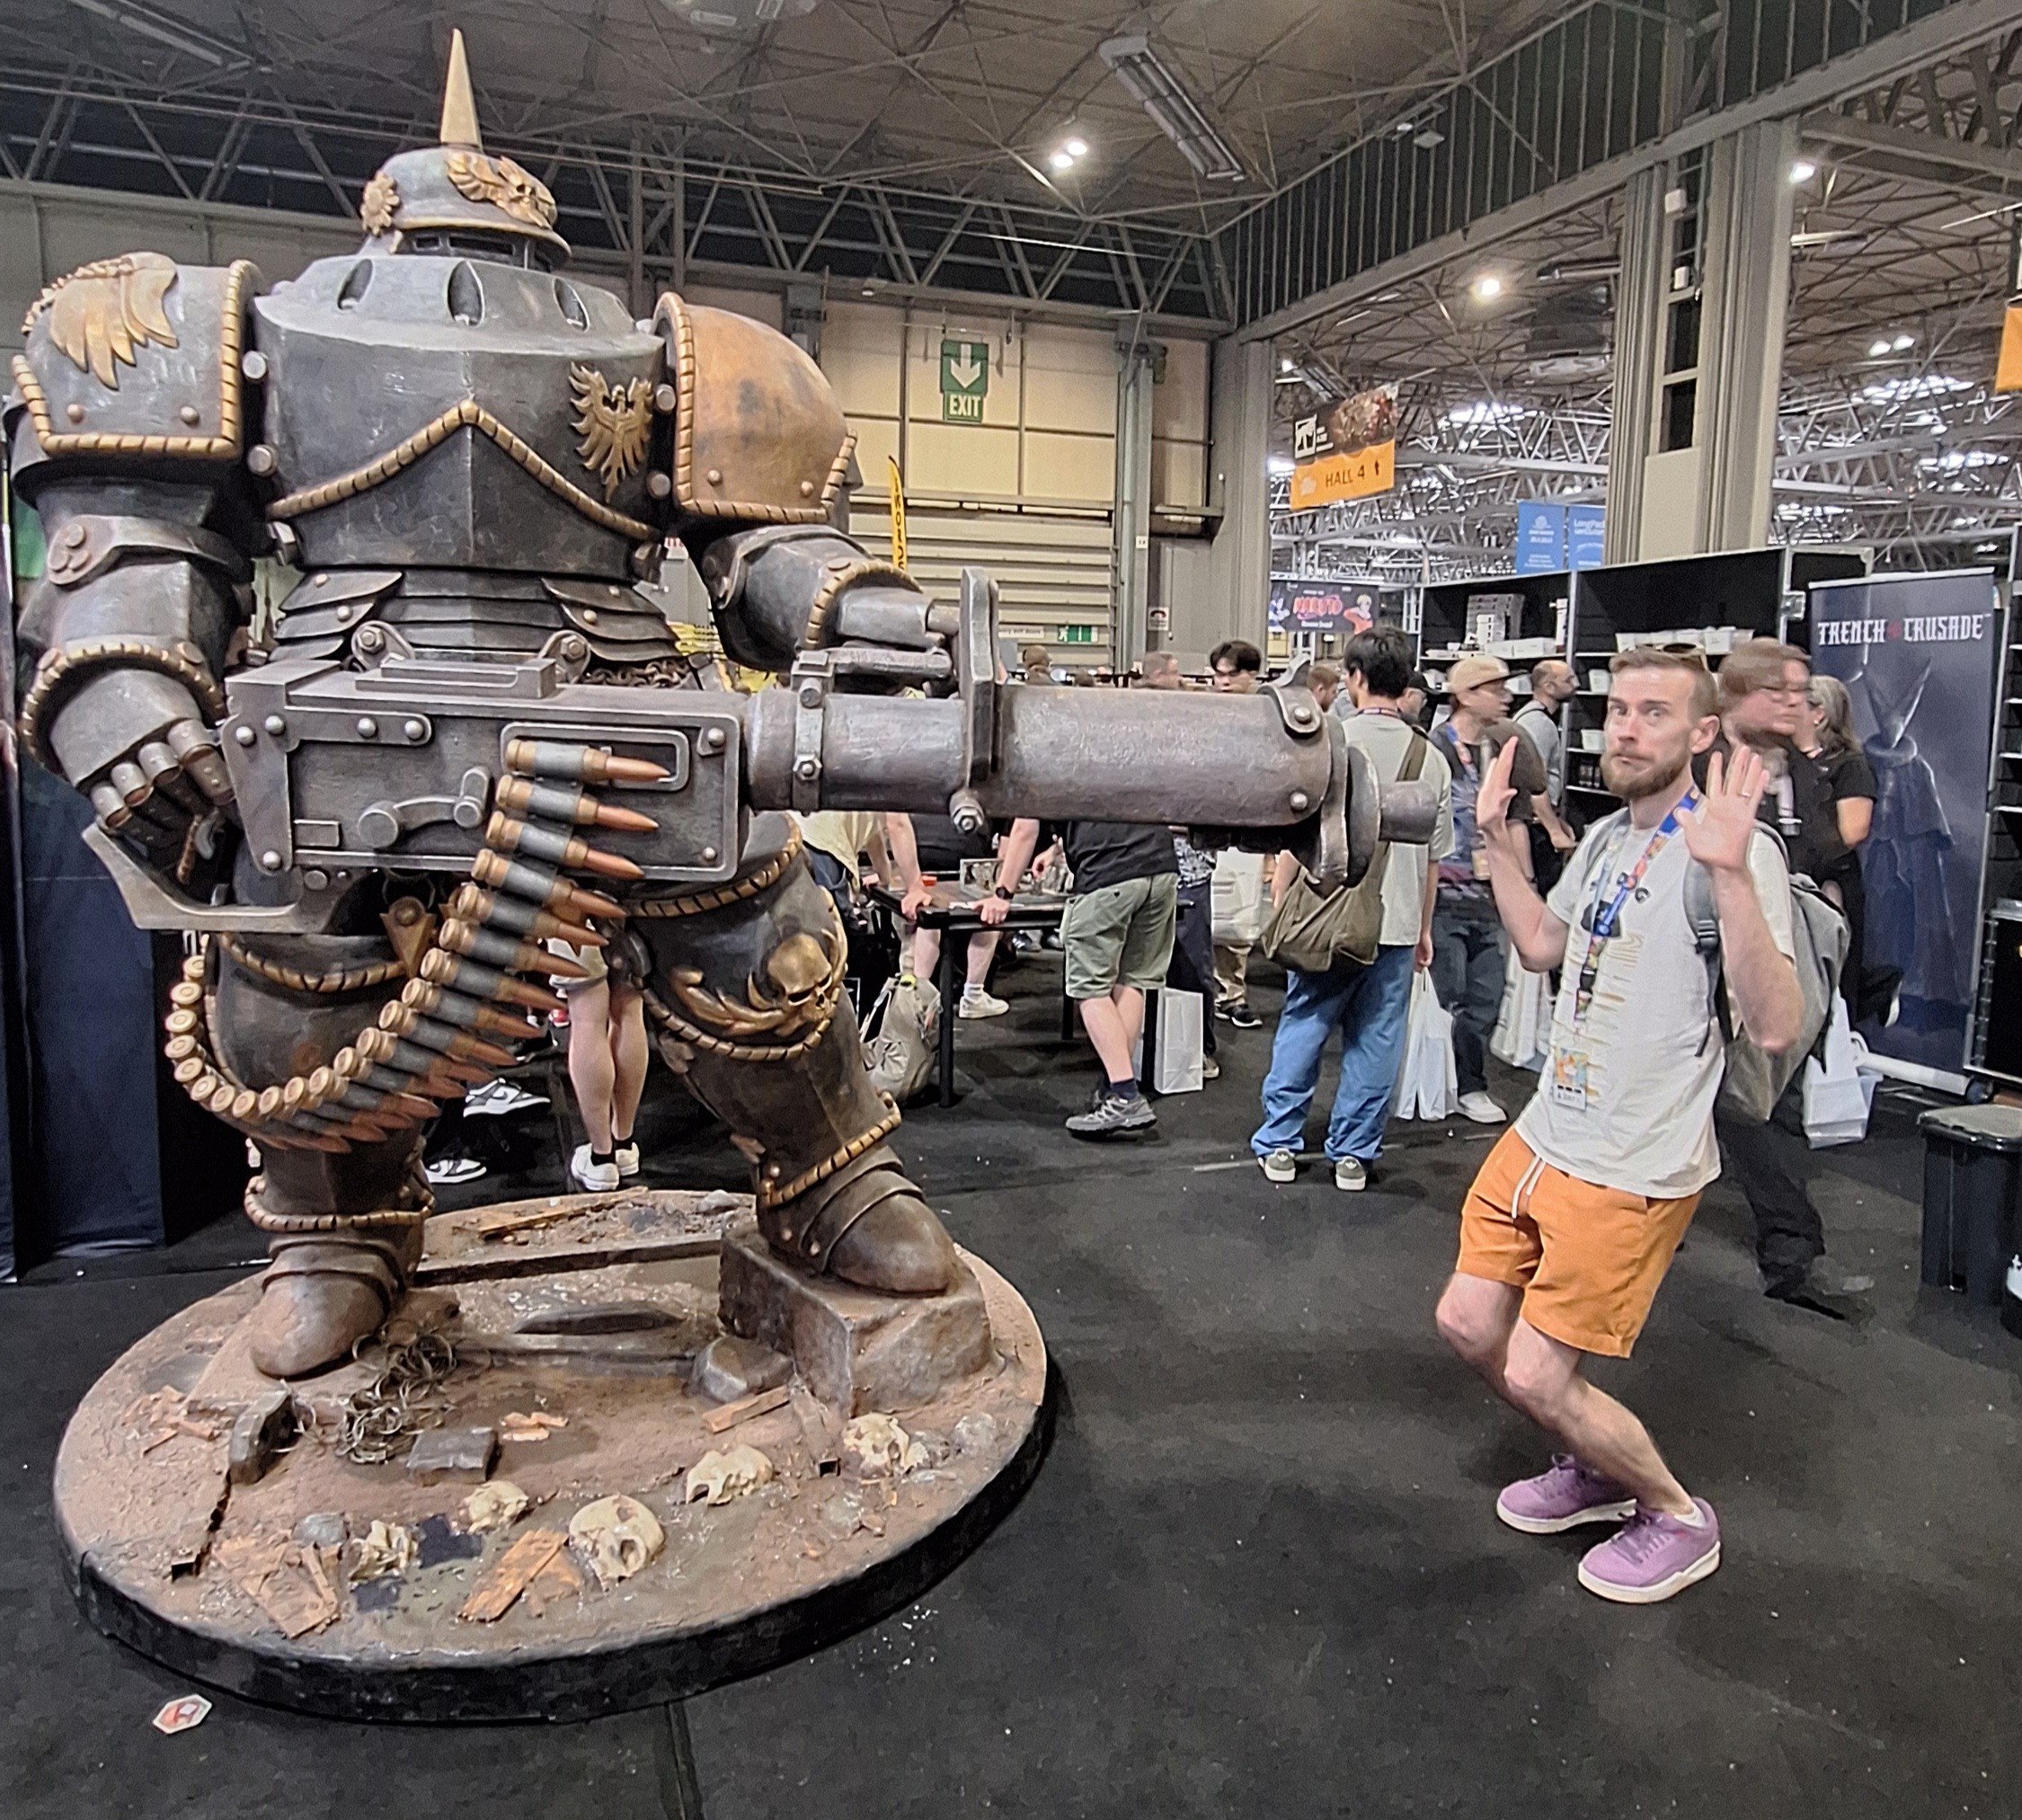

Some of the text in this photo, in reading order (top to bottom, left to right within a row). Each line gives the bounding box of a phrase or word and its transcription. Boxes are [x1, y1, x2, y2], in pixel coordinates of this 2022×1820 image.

[949, 394, 981, 417] EXIT
[1326, 465, 1365, 487] HALL 4
[1817, 614, 1983, 646] TRENCH CRUSADE
